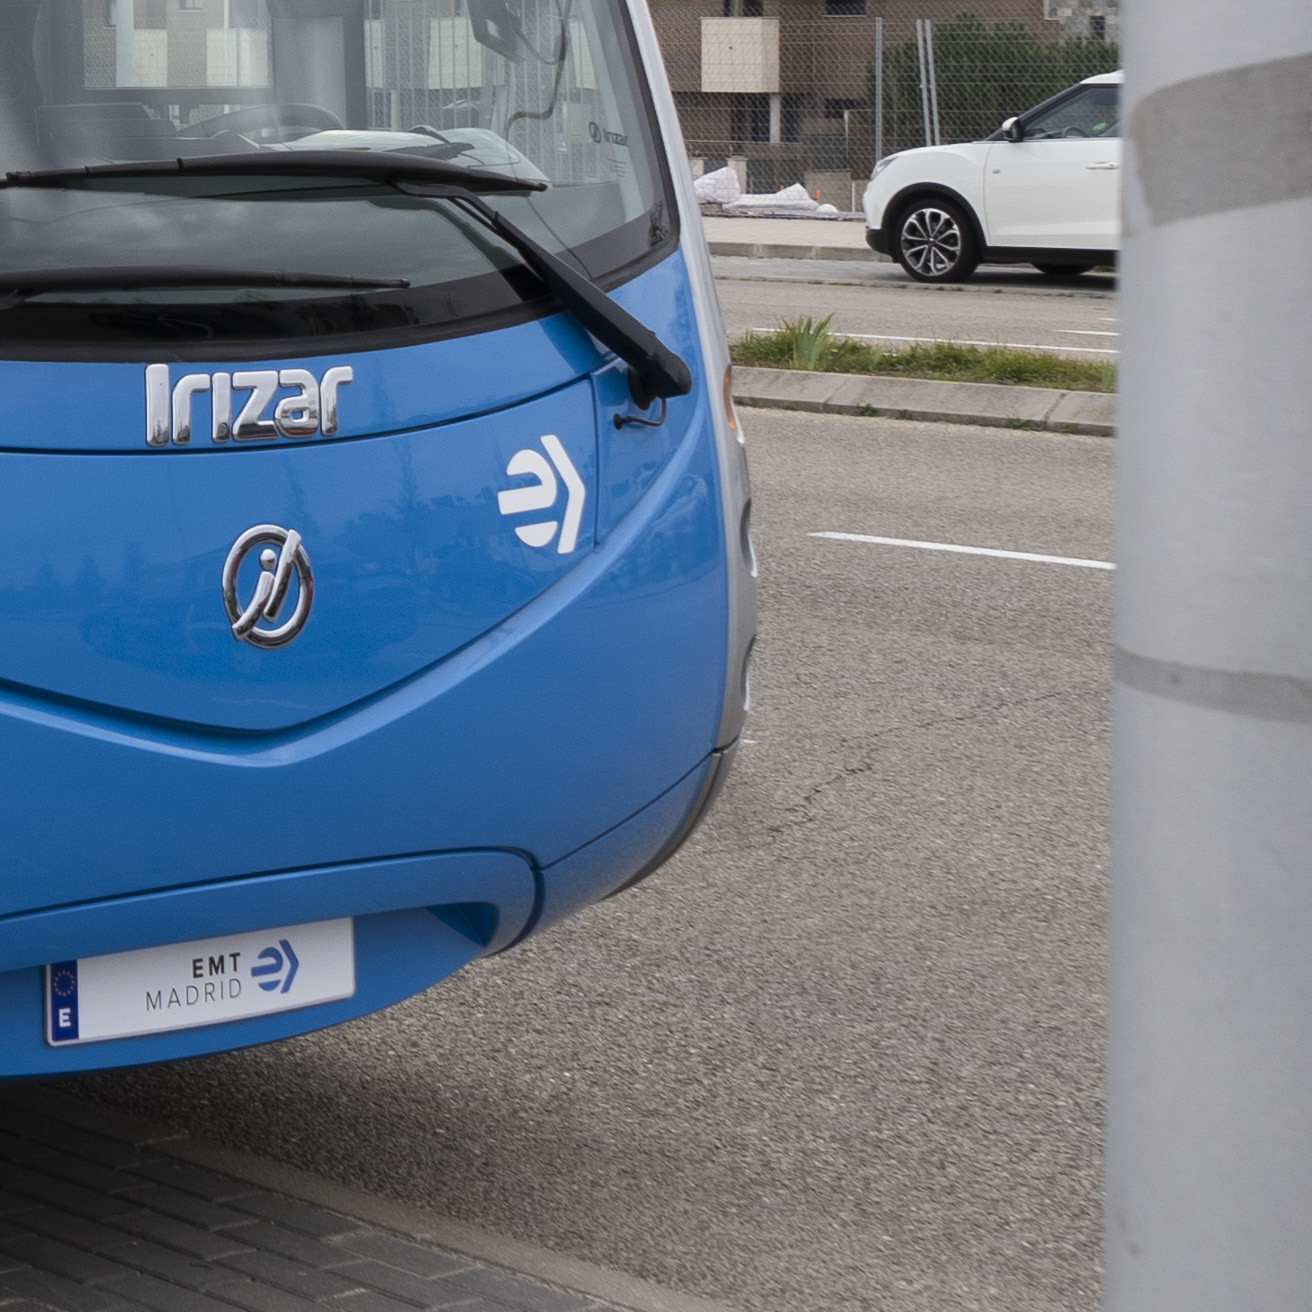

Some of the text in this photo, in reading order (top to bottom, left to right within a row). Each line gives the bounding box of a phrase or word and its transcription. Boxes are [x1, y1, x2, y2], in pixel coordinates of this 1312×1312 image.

[144, 363, 354, 447] Irizar
[192, 952, 241, 979] EMT
[145, 978, 242, 1012] MADRID
[58, 1007, 72, 1028] E
